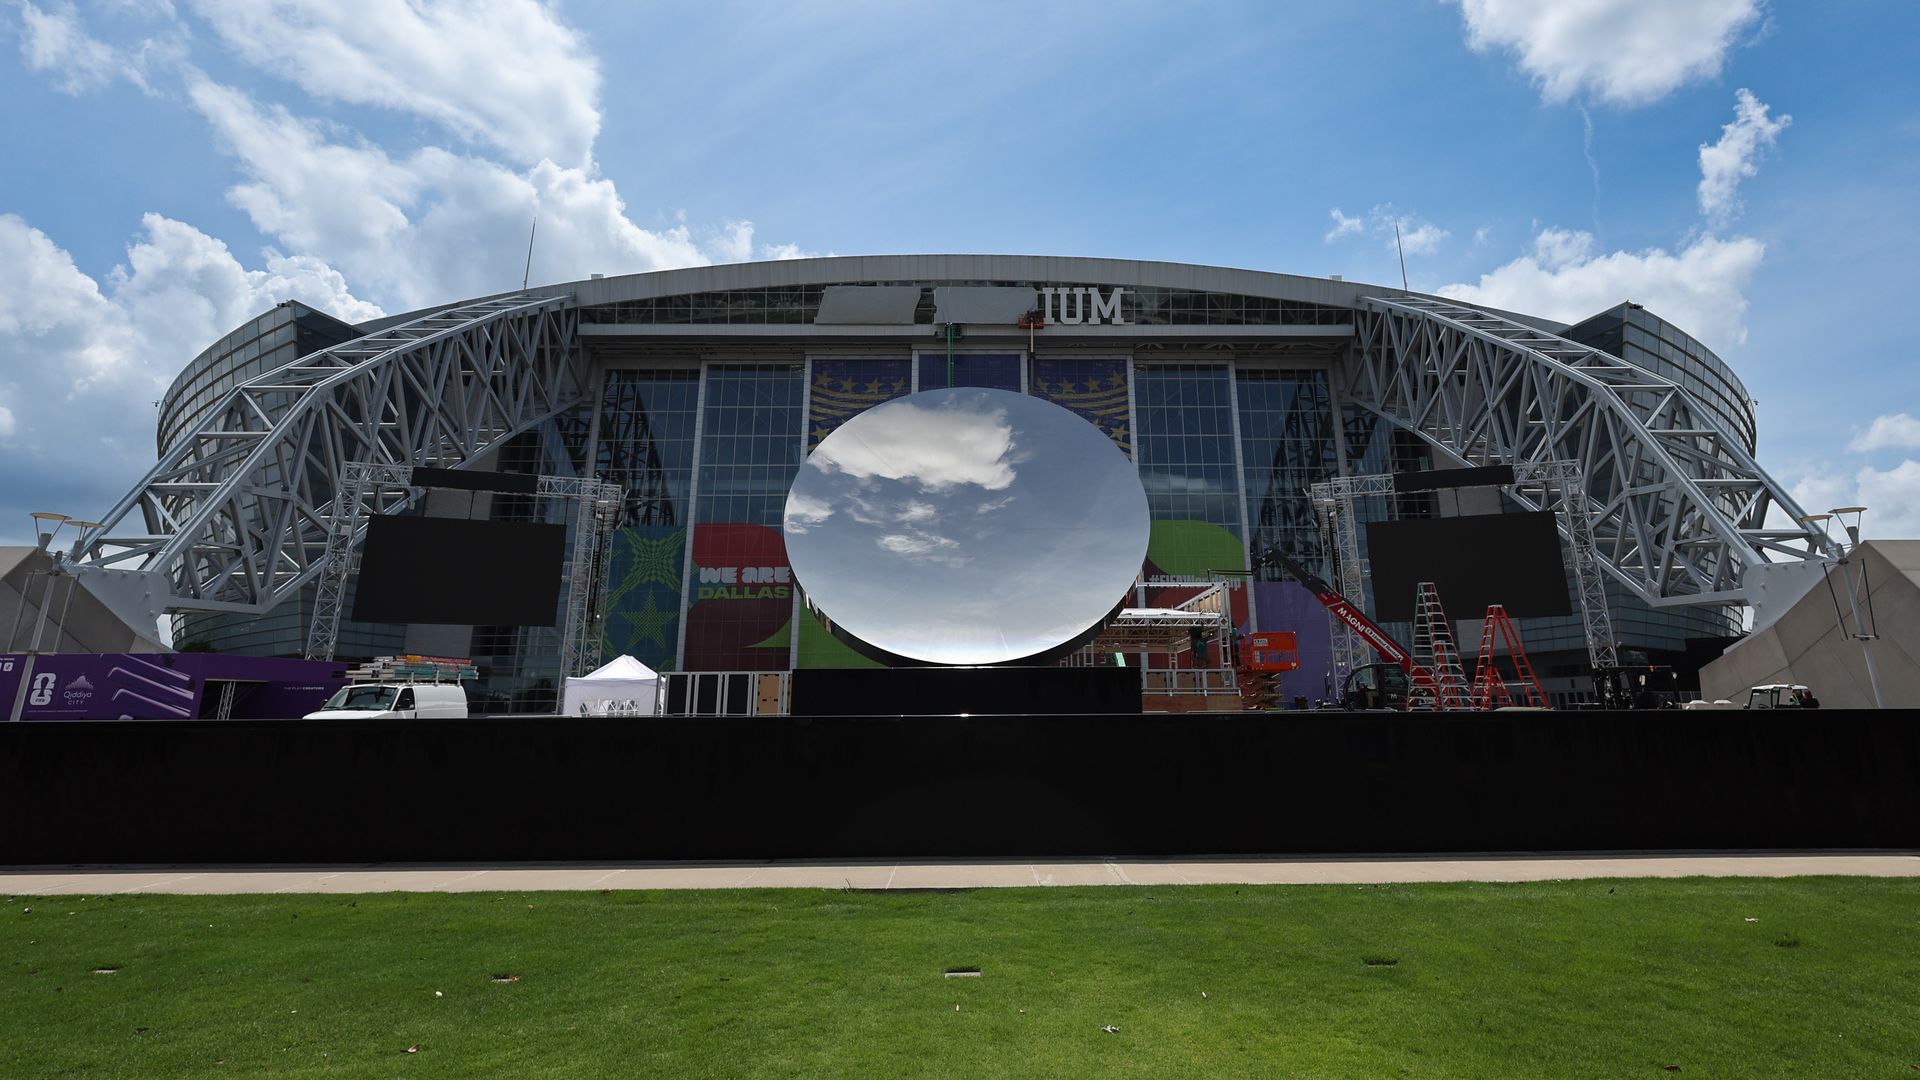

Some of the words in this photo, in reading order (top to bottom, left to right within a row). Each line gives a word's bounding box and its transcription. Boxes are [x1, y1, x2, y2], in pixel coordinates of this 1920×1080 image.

[1042, 287, 1124, 325] IUM
[699, 567, 738, 584] WE
[741, 566, 791, 584] ARE
[698, 586, 790, 599] DALLAS
[1337, 607, 1366, 632] MAGNI
[63, 690, 92, 699] Qiddiya
